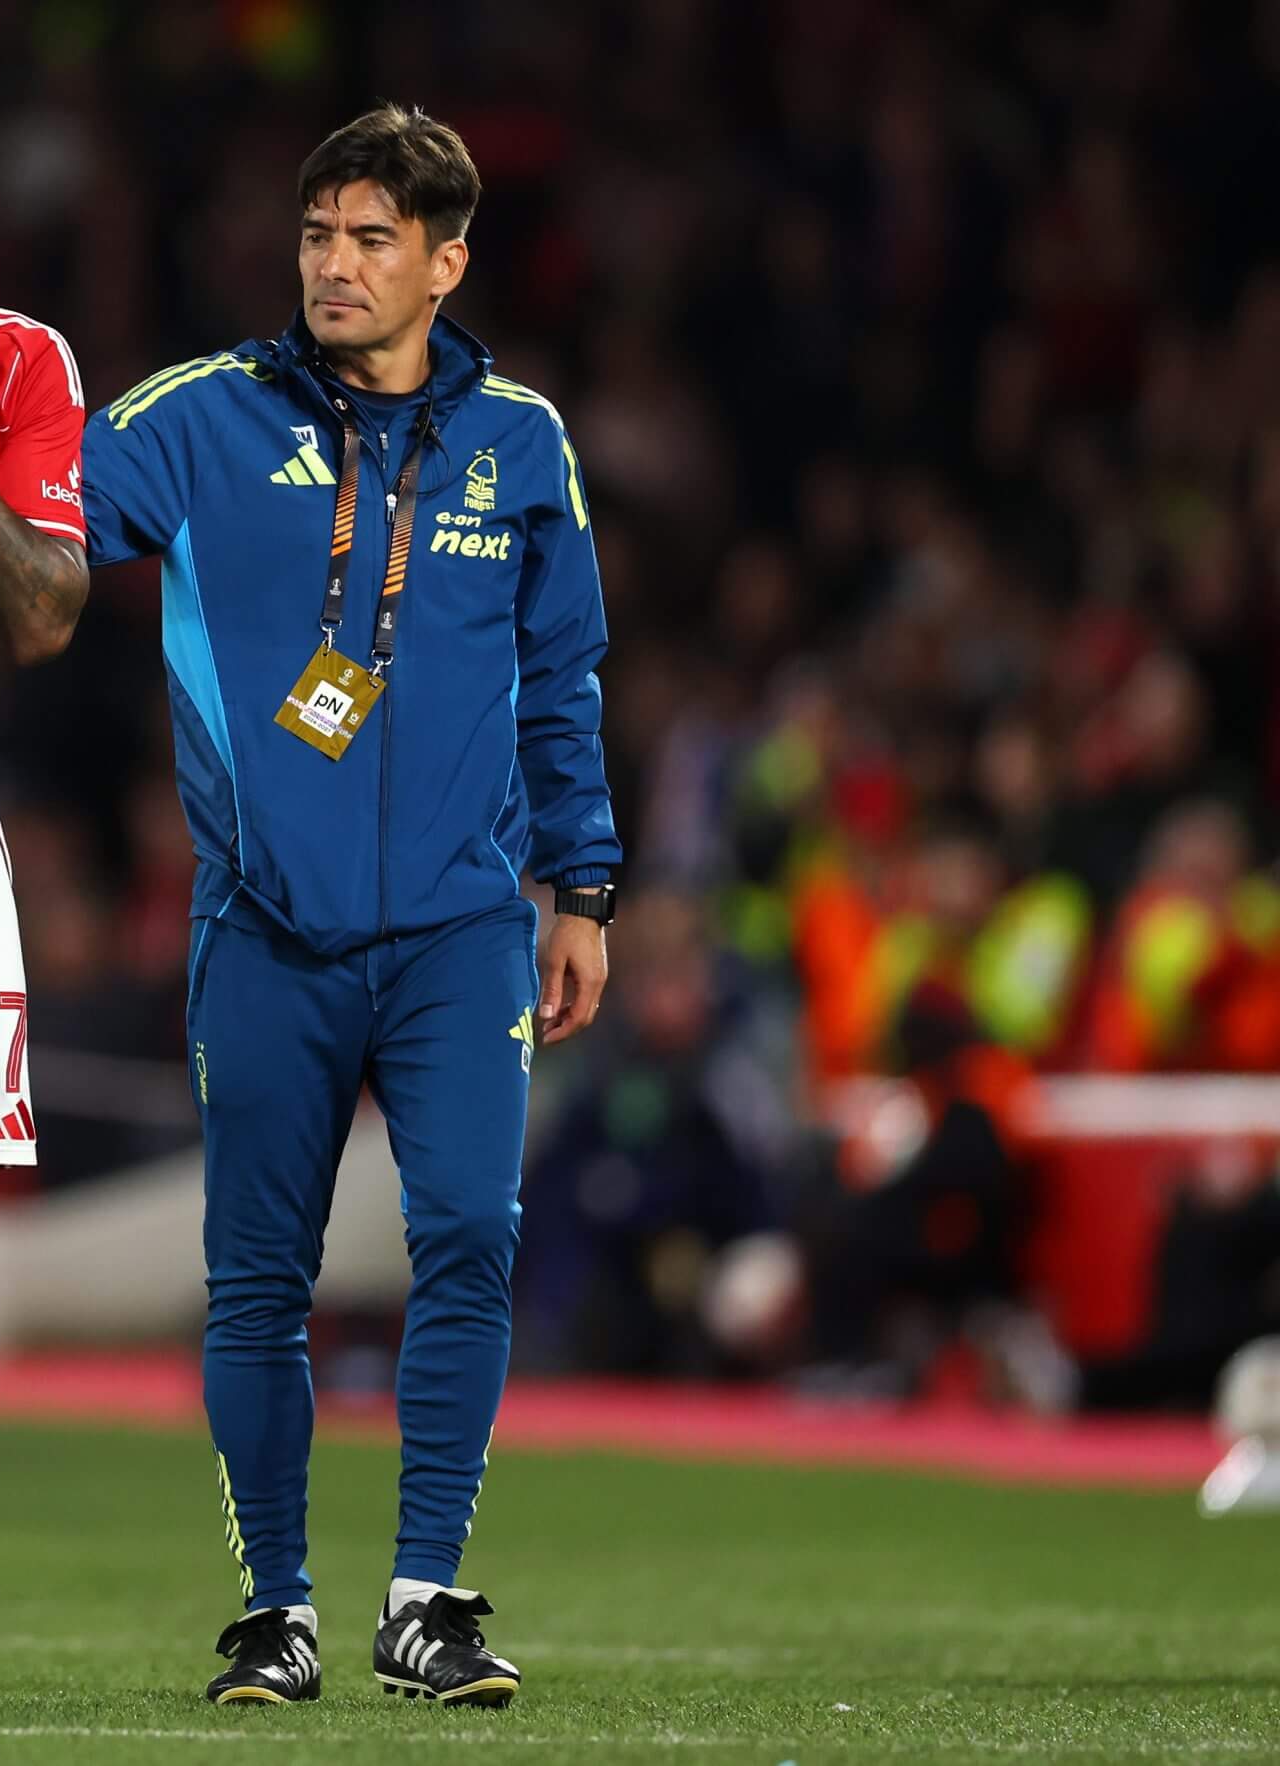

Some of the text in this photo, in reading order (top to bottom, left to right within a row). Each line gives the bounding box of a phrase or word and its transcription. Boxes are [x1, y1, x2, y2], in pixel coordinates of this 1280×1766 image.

[41, 479, 84, 517] Idea
[464, 496, 496, 512] FOREST
[430, 529, 511, 560] next
